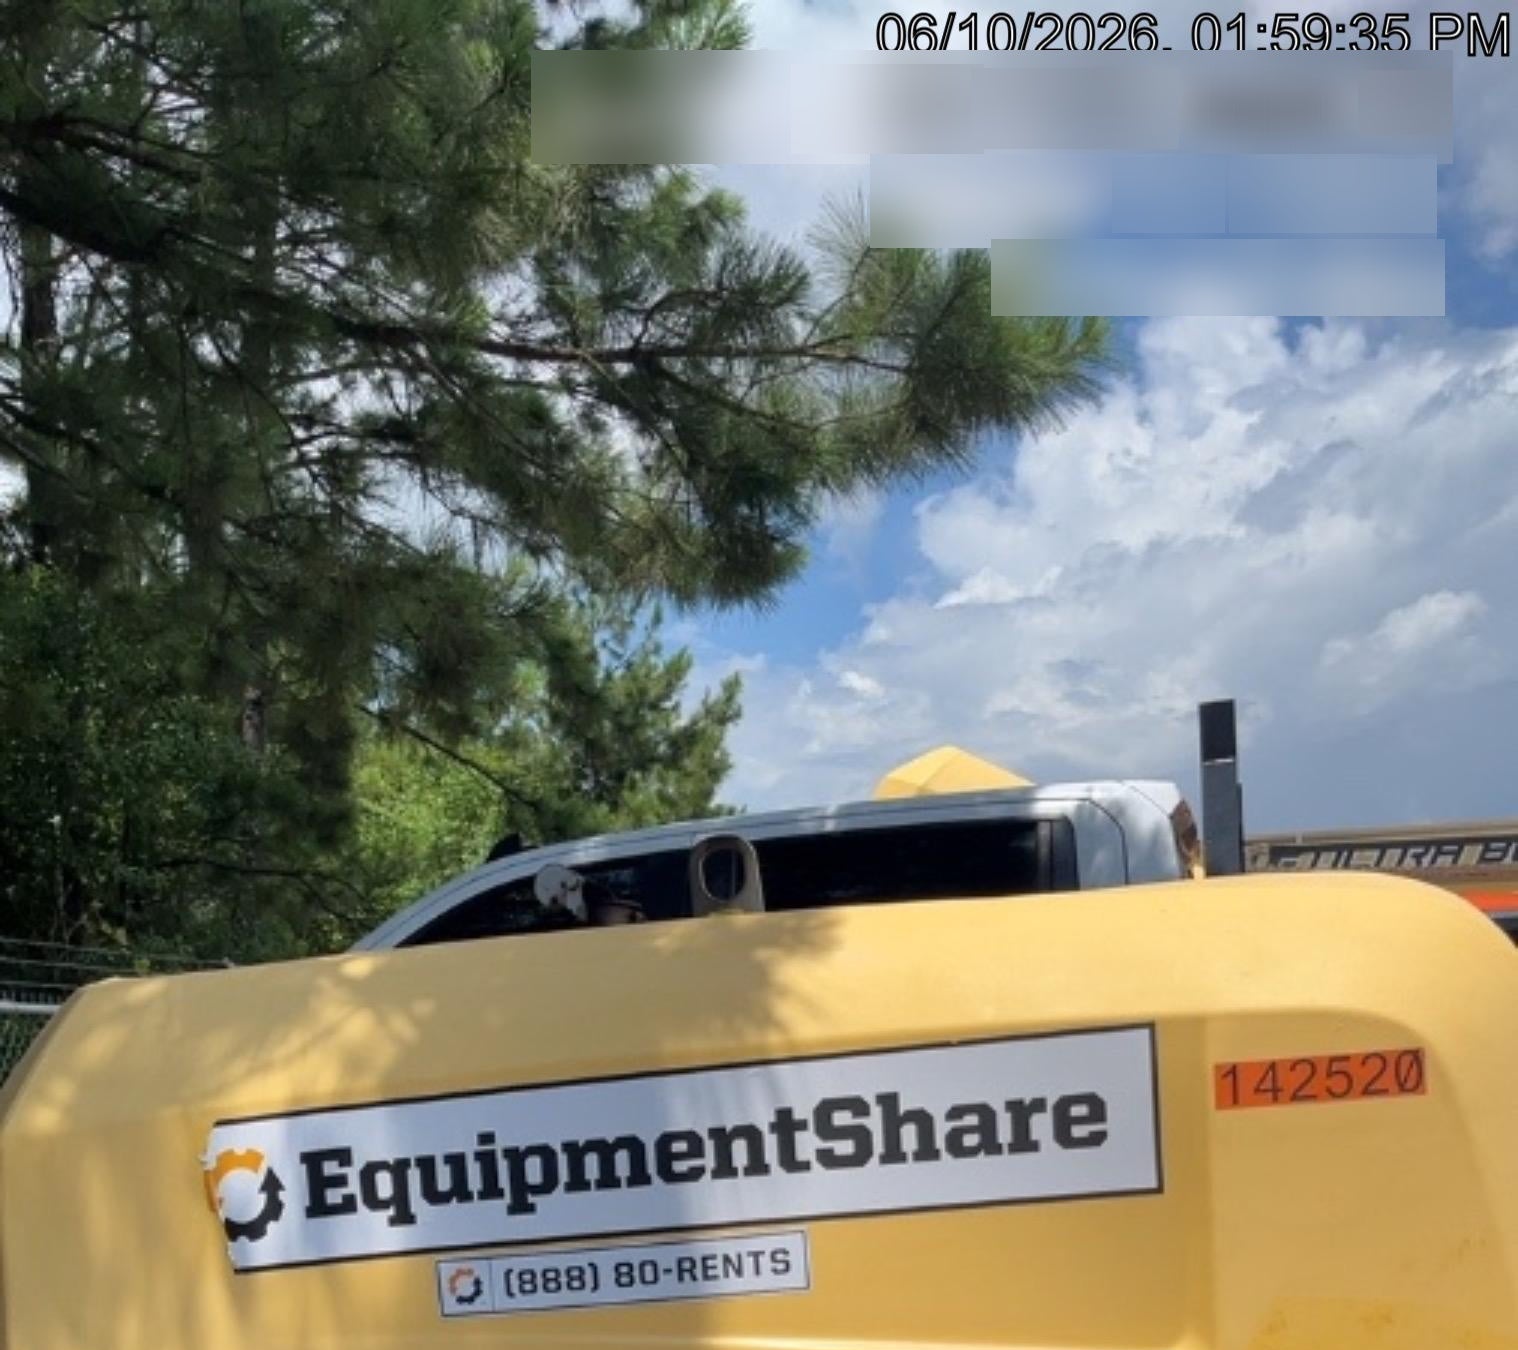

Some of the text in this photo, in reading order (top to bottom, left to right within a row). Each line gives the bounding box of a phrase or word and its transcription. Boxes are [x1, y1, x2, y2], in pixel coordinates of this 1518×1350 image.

[1221, 1049, 1423, 1105] 142520
[299, 1091, 1109, 1227] EquipmentShare
[504, 1248, 792, 1298] (888) 80-RENTS
